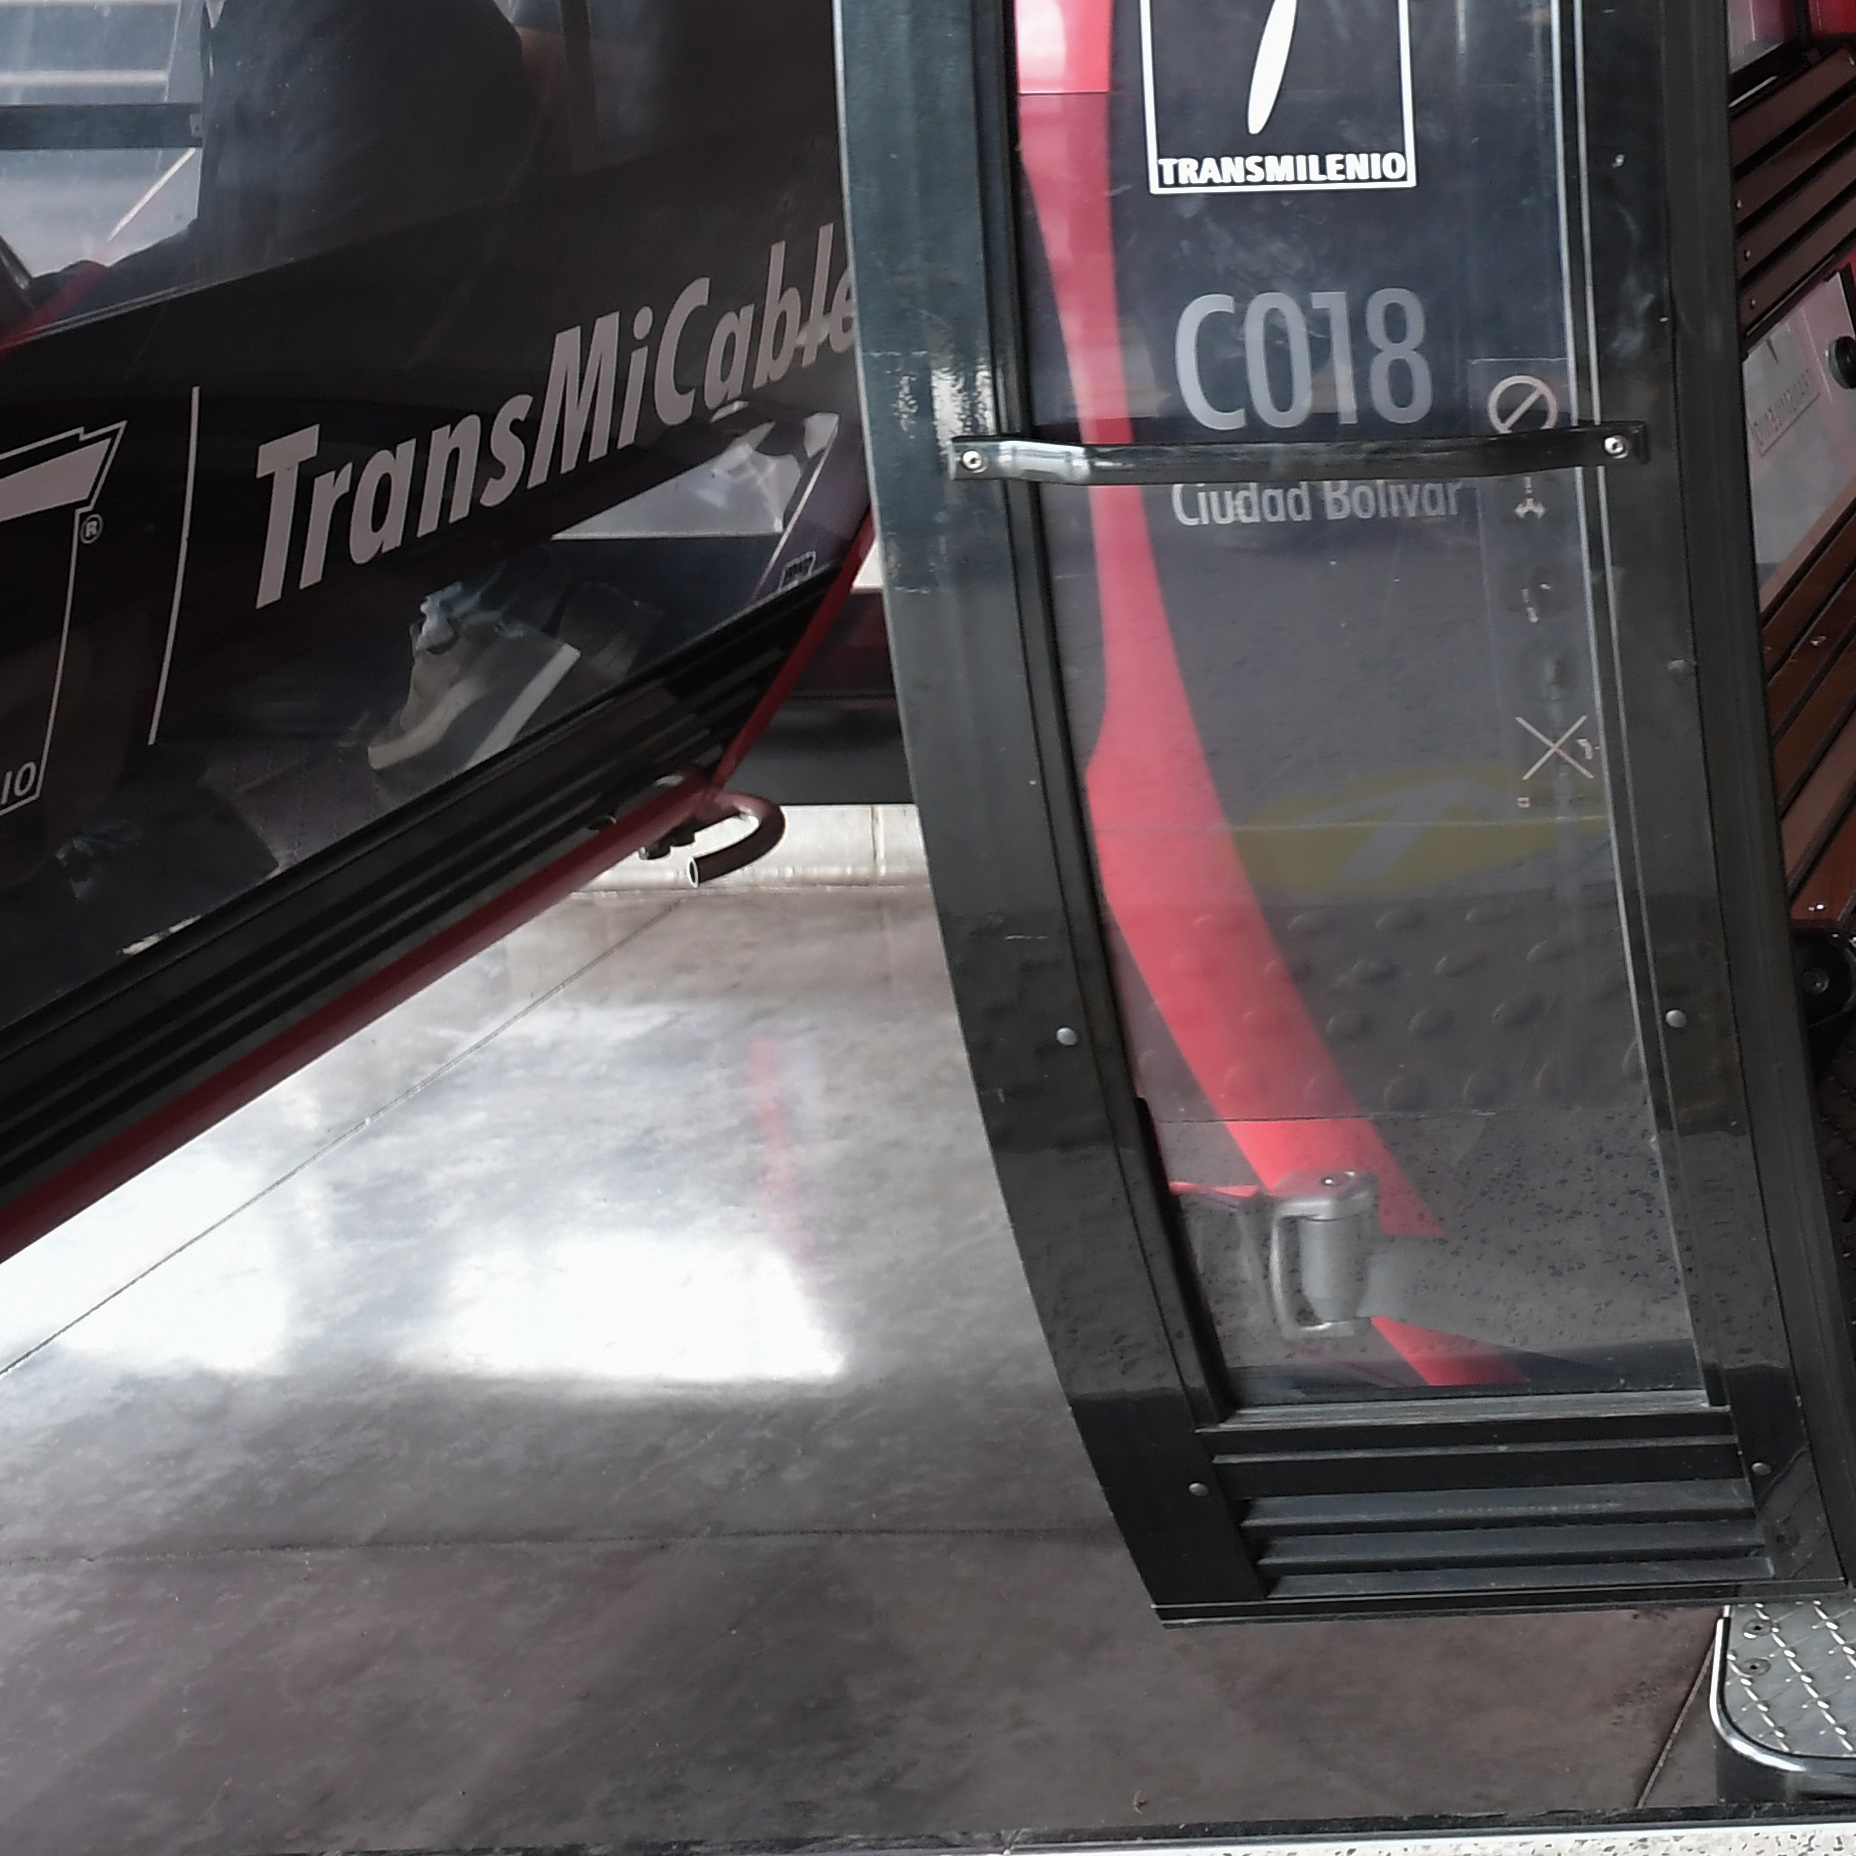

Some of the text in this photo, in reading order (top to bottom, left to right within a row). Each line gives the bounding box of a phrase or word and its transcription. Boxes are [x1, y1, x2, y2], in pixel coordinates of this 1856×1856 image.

[1158, 152, 1406, 184] TRANSMILENIO
[1174, 287, 1434, 431] C018
[1170, 482, 1312, 527] Ciudad
